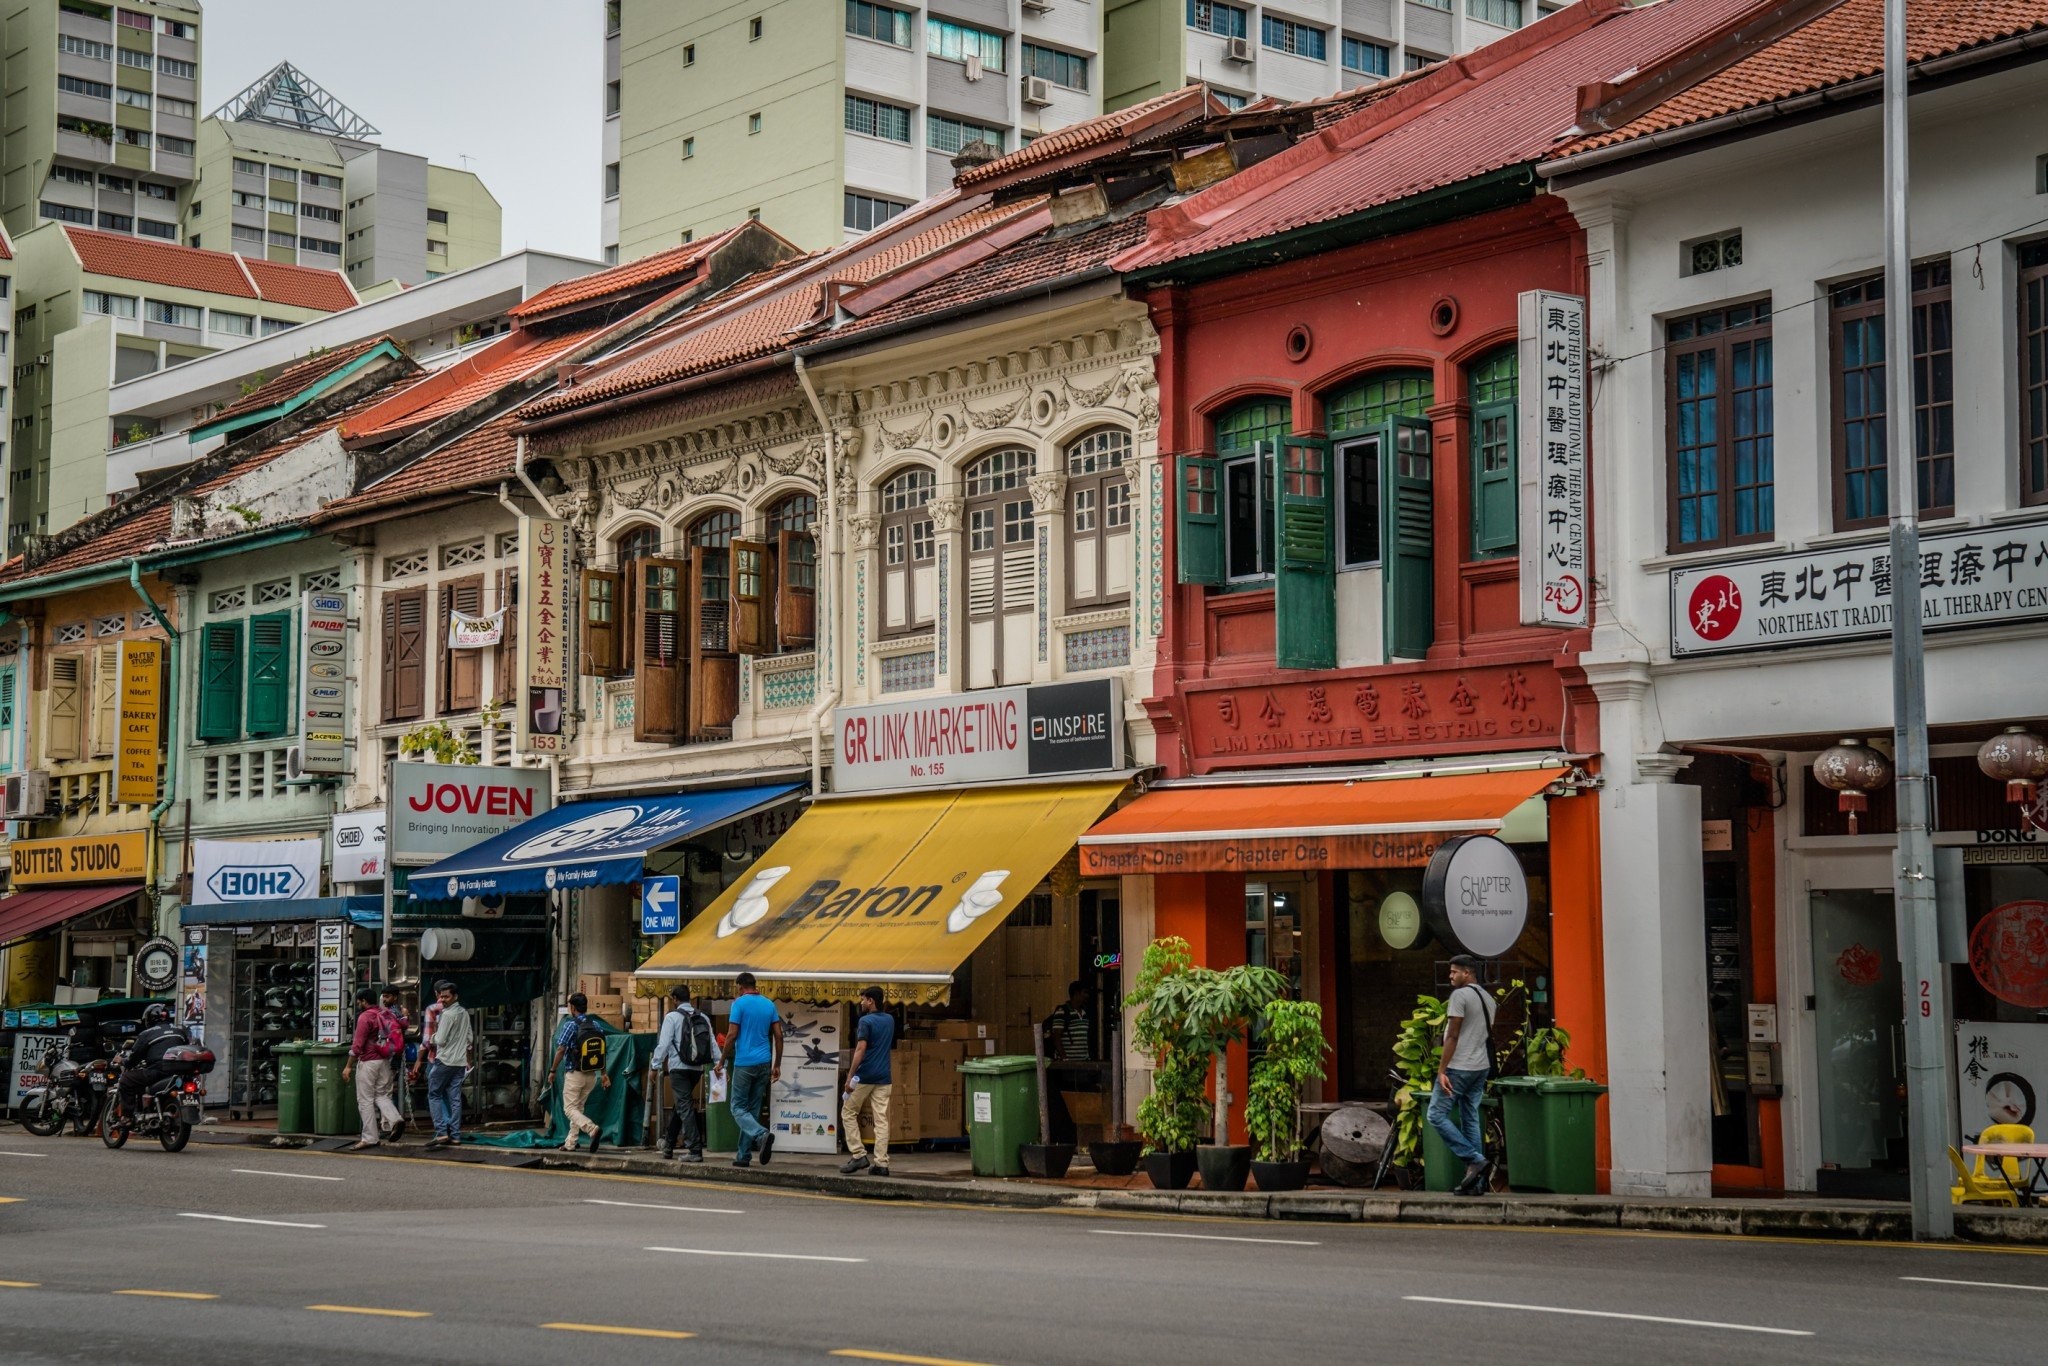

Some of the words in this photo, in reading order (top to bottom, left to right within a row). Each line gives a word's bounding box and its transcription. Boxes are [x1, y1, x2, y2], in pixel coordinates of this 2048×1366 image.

[1568, 310, 1580, 382] NORTHEAST
[1569, 385, 1581, 464] TRADITIONAL
[1547, 307, 1568, 566] 東北中醫理療中心
[1569, 468, 1582, 521] THERAPY
[1570, 523, 1582, 570] CENTRE
[1545, 586, 1562, 602] 24
[316, 599, 340, 610] SHOEI
[537, 545, 556, 664] 寶生五金企業
[1758, 610, 1839, 636] NORTHEAST
[1842, 598, 1941, 626] TRADITAL
[1944, 590, 2013, 616] THERAPY
[310, 620, 344, 632] NOLAN
[128, 652, 155, 660] BUTTER
[123, 711, 156, 720] BAKERY
[844, 717, 868, 765] GR
[873, 712, 909, 762] LINK
[914, 700, 1017, 758] MARKETING
[1211, 735, 1248, 753] LIM
[1254, 732, 1294, 750] KIM
[1300, 727, 1364, 747] THYE
[1372, 718, 1497, 743] ELECTRIC
[531, 736, 556, 749] 153
[910, 764, 926, 777] No.
[928, 763, 945, 775] 155
[408, 783, 533, 817] JOVEN
[340, 831, 360, 843] SHOEI
[408, 822, 448, 837] Bringing
[452, 823, 500, 834] Innovation
[14, 847, 63, 875] BUTTER
[70, 843, 121, 872] STUDIO
[1089, 851, 1147, 868] Chapter
[1153, 849, 1184, 865] One
[1225, 846, 1288, 864] Chapter
[1295, 843, 1329, 862] One
[565, 870, 580, 881] Family
[581, 869, 597, 878] Heater
[459, 882, 466, 891] My
[466, 881, 481, 891] Family
[481, 880, 496, 888] Heater
[1461, 876, 1512, 892] CHAPTER
[780, 880, 943, 919] Baron
[1461, 890, 1487, 906] ONE
[645, 916, 658, 928] ONE
[661, 916, 675, 927] WAY
[777, 984, 804, 995] kitchen
[805, 985, 820, 996] sink
[832, 985, 861, 997] bathroo
[1963, 1035, 1989, 1086] 推拿
